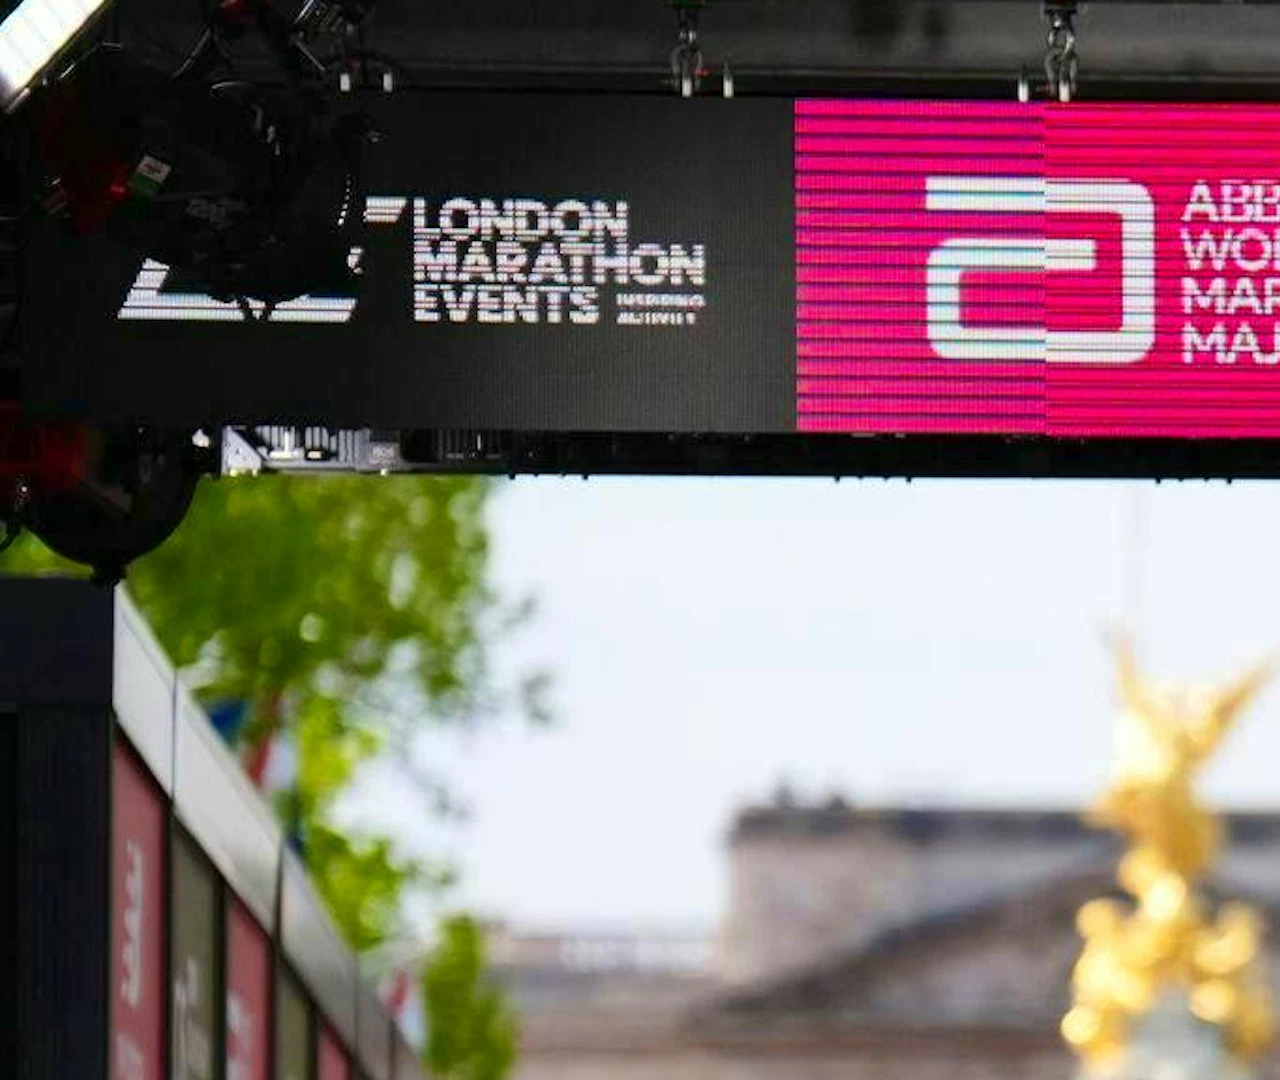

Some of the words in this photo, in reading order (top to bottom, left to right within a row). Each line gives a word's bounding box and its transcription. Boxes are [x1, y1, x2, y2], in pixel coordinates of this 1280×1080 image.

[413, 198, 628, 241] LONDON
[413, 240, 705, 284] MARATHON
[413, 283, 600, 323] EVENTS
